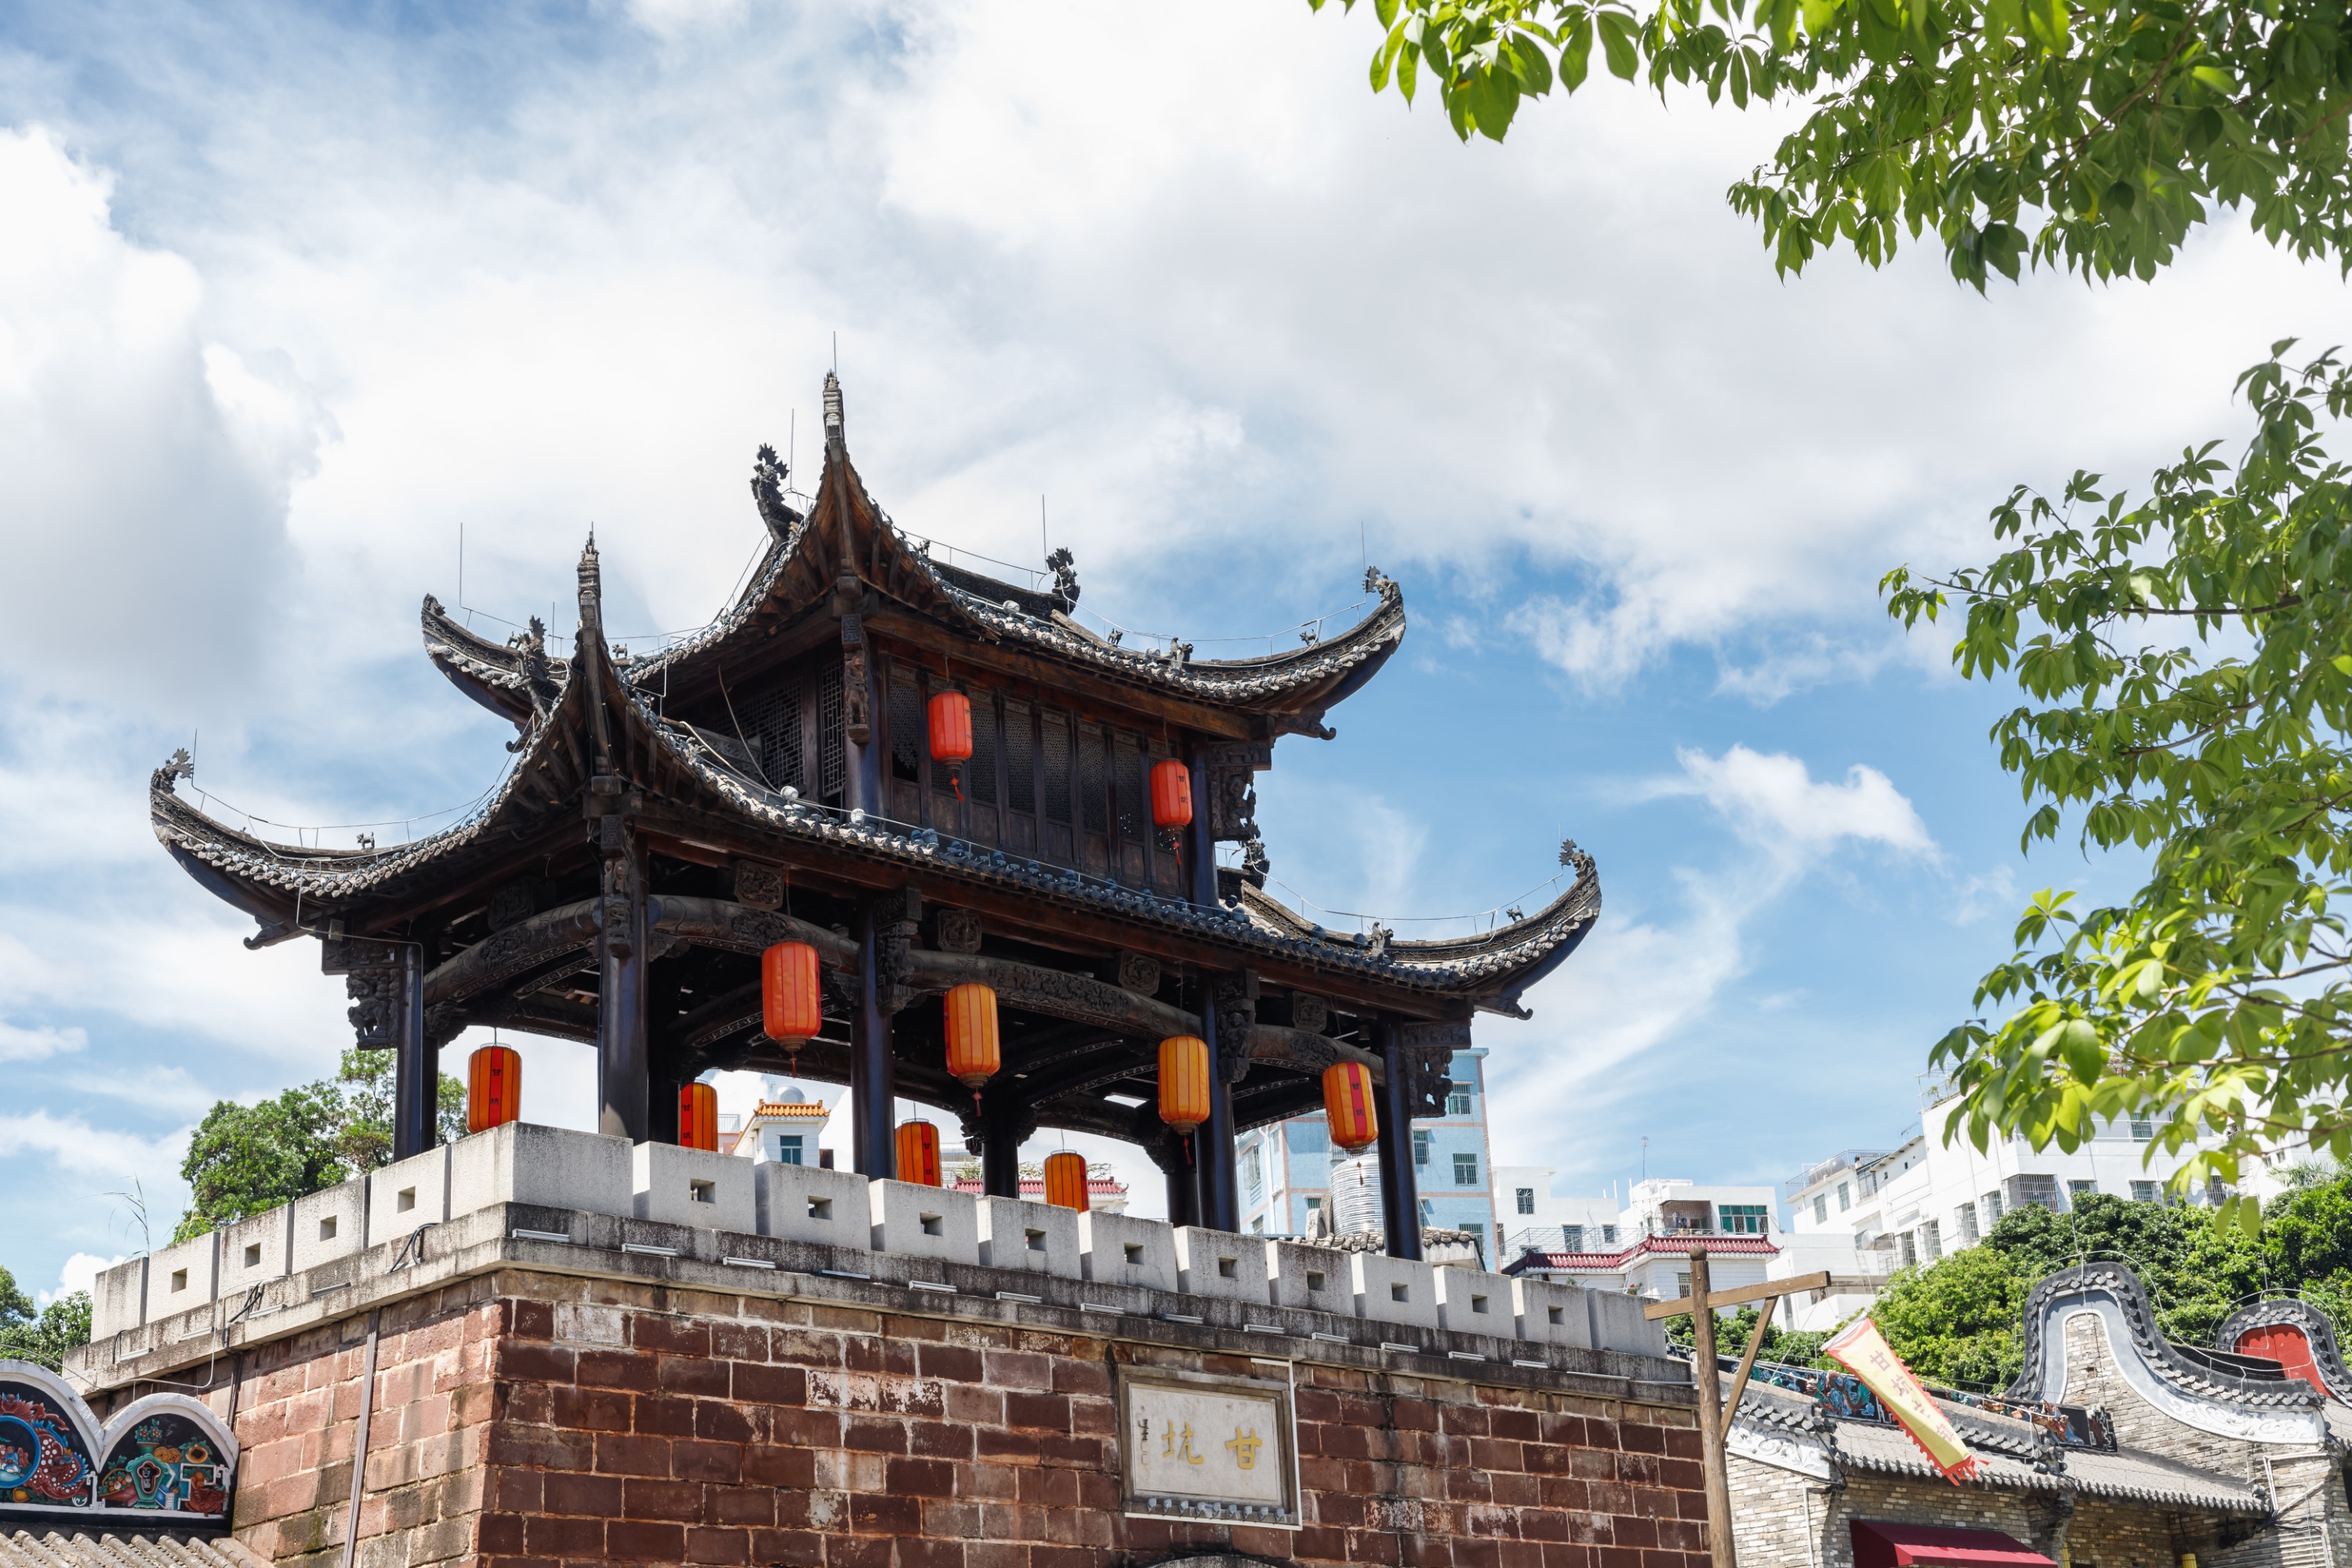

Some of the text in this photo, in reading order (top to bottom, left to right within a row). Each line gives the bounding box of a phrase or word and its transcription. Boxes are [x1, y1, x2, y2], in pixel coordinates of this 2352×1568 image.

[490, 1069, 502, 1105] 甘坑
[1352, 1083, 1364, 1116] 甘坑
[682, 1104, 693, 1139] 甘坑
